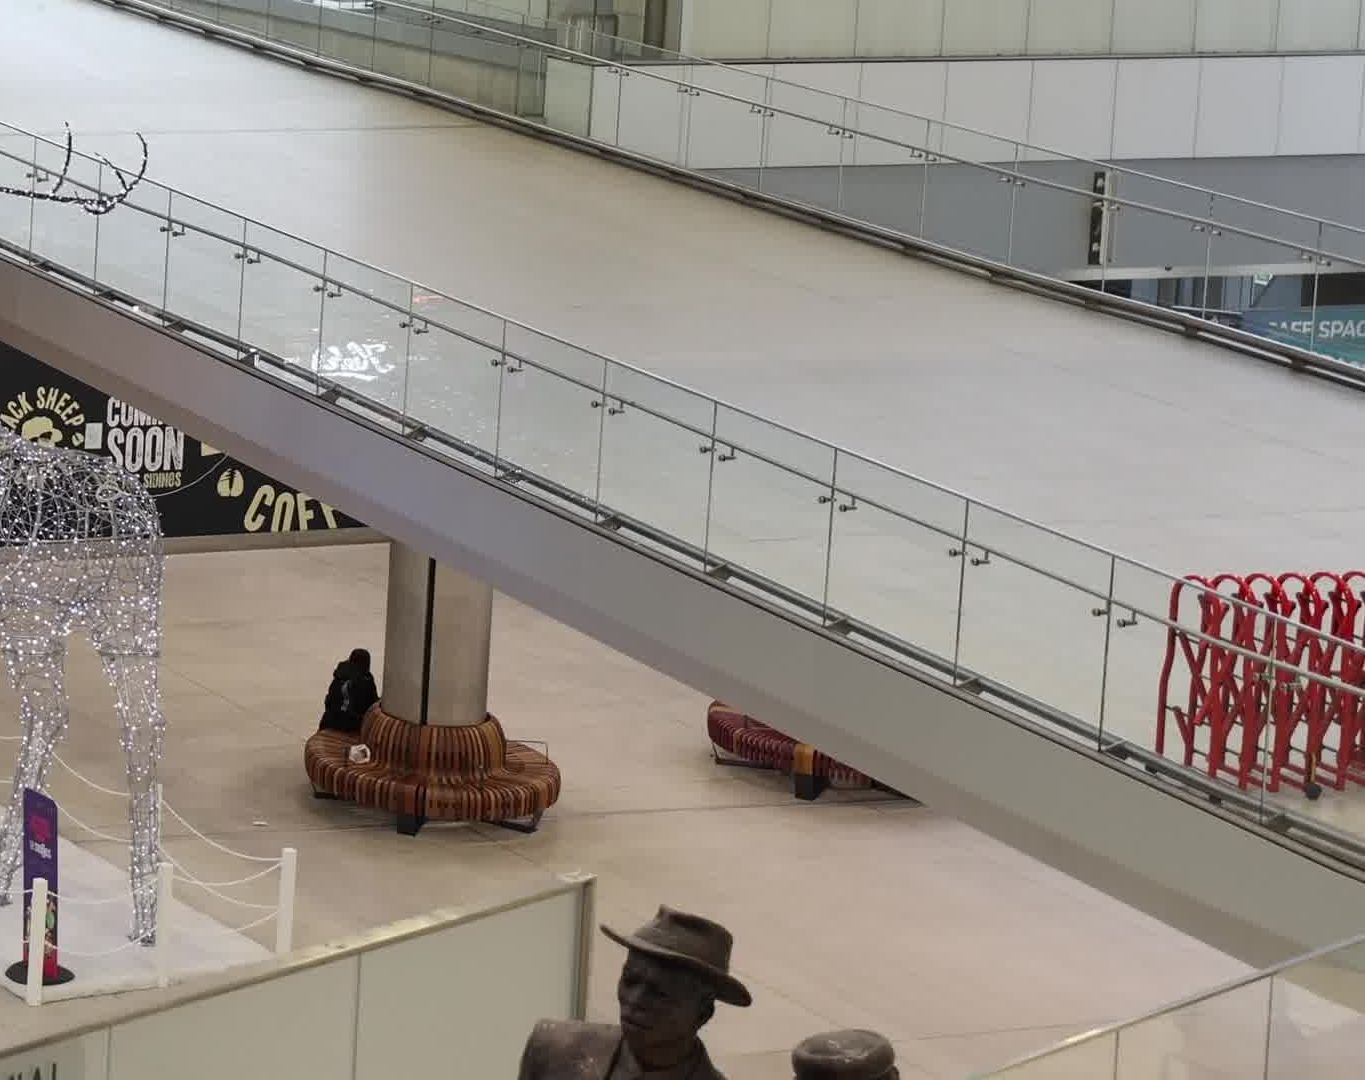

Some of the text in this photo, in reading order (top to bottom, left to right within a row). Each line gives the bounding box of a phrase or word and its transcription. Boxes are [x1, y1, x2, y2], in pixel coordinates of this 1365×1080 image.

[0, 385, 85, 430] ACK SHEEP
[106, 426, 185, 473] SOON
[142, 471, 183, 489] SIDINGS
